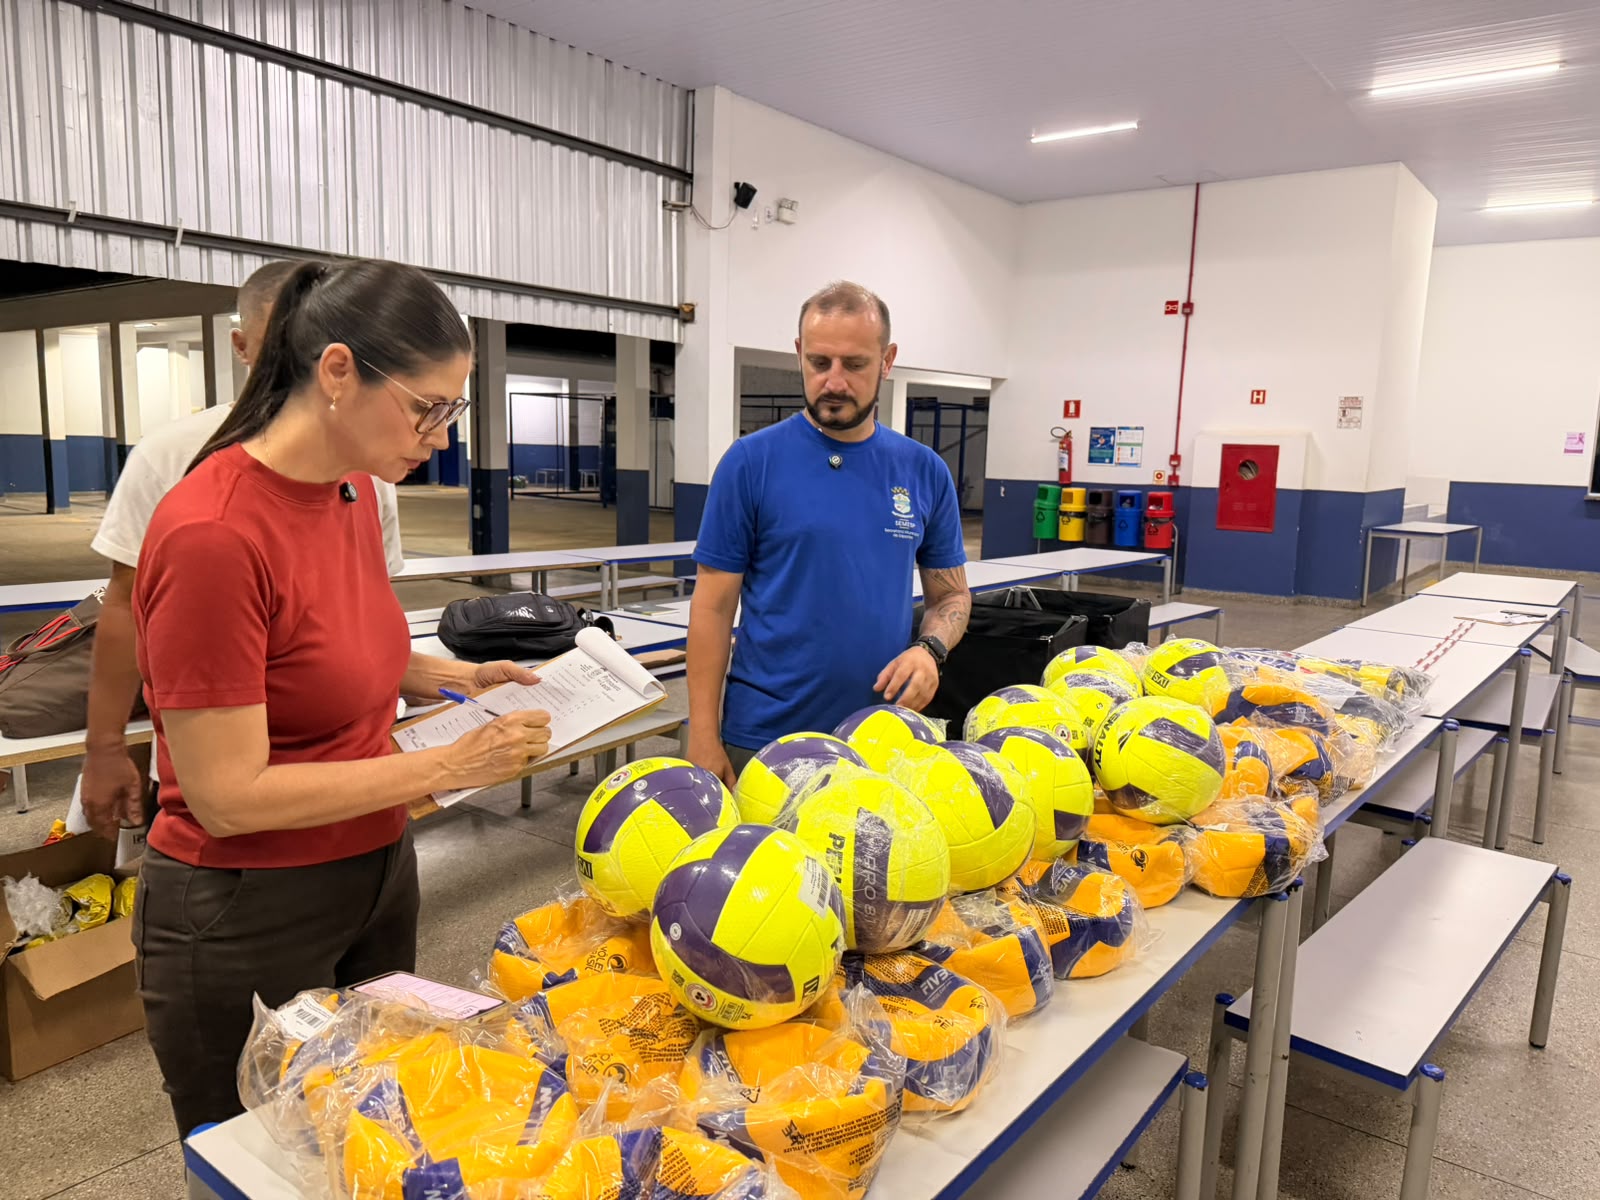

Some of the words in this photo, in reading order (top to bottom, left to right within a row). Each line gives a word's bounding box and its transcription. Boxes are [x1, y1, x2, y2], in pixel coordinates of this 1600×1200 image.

[1252, 391, 1264, 403] H
[920, 968, 949, 996] FIVB
[934, 1019, 950, 1031] PE
